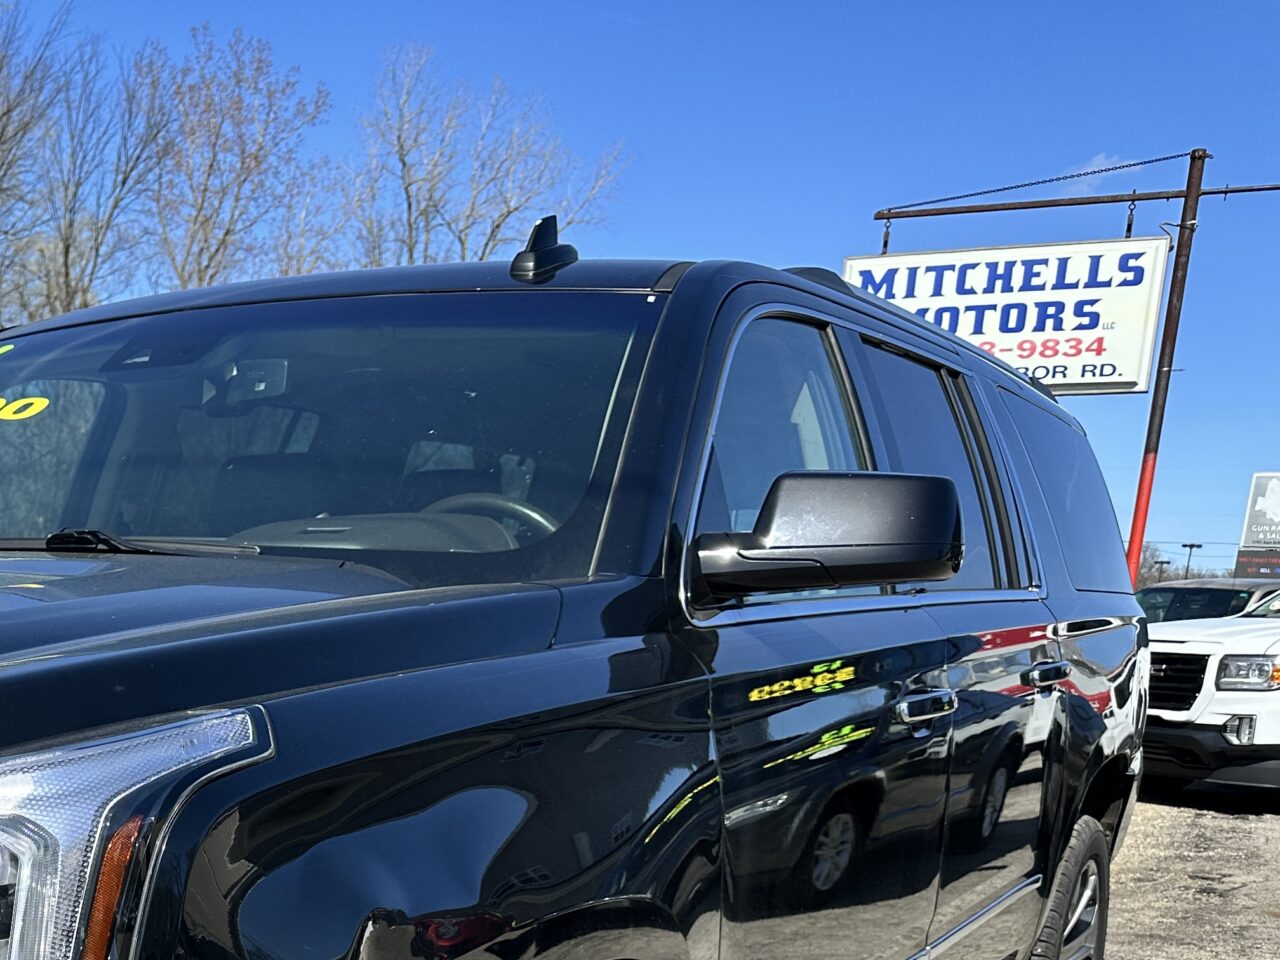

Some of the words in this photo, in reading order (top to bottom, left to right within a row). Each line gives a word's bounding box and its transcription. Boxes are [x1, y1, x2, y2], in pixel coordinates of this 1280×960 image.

[858, 252, 1147, 300] MITCHELLS
[912, 298, 1103, 336] OTORS
[1080, 363, 1123, 378] RD.
